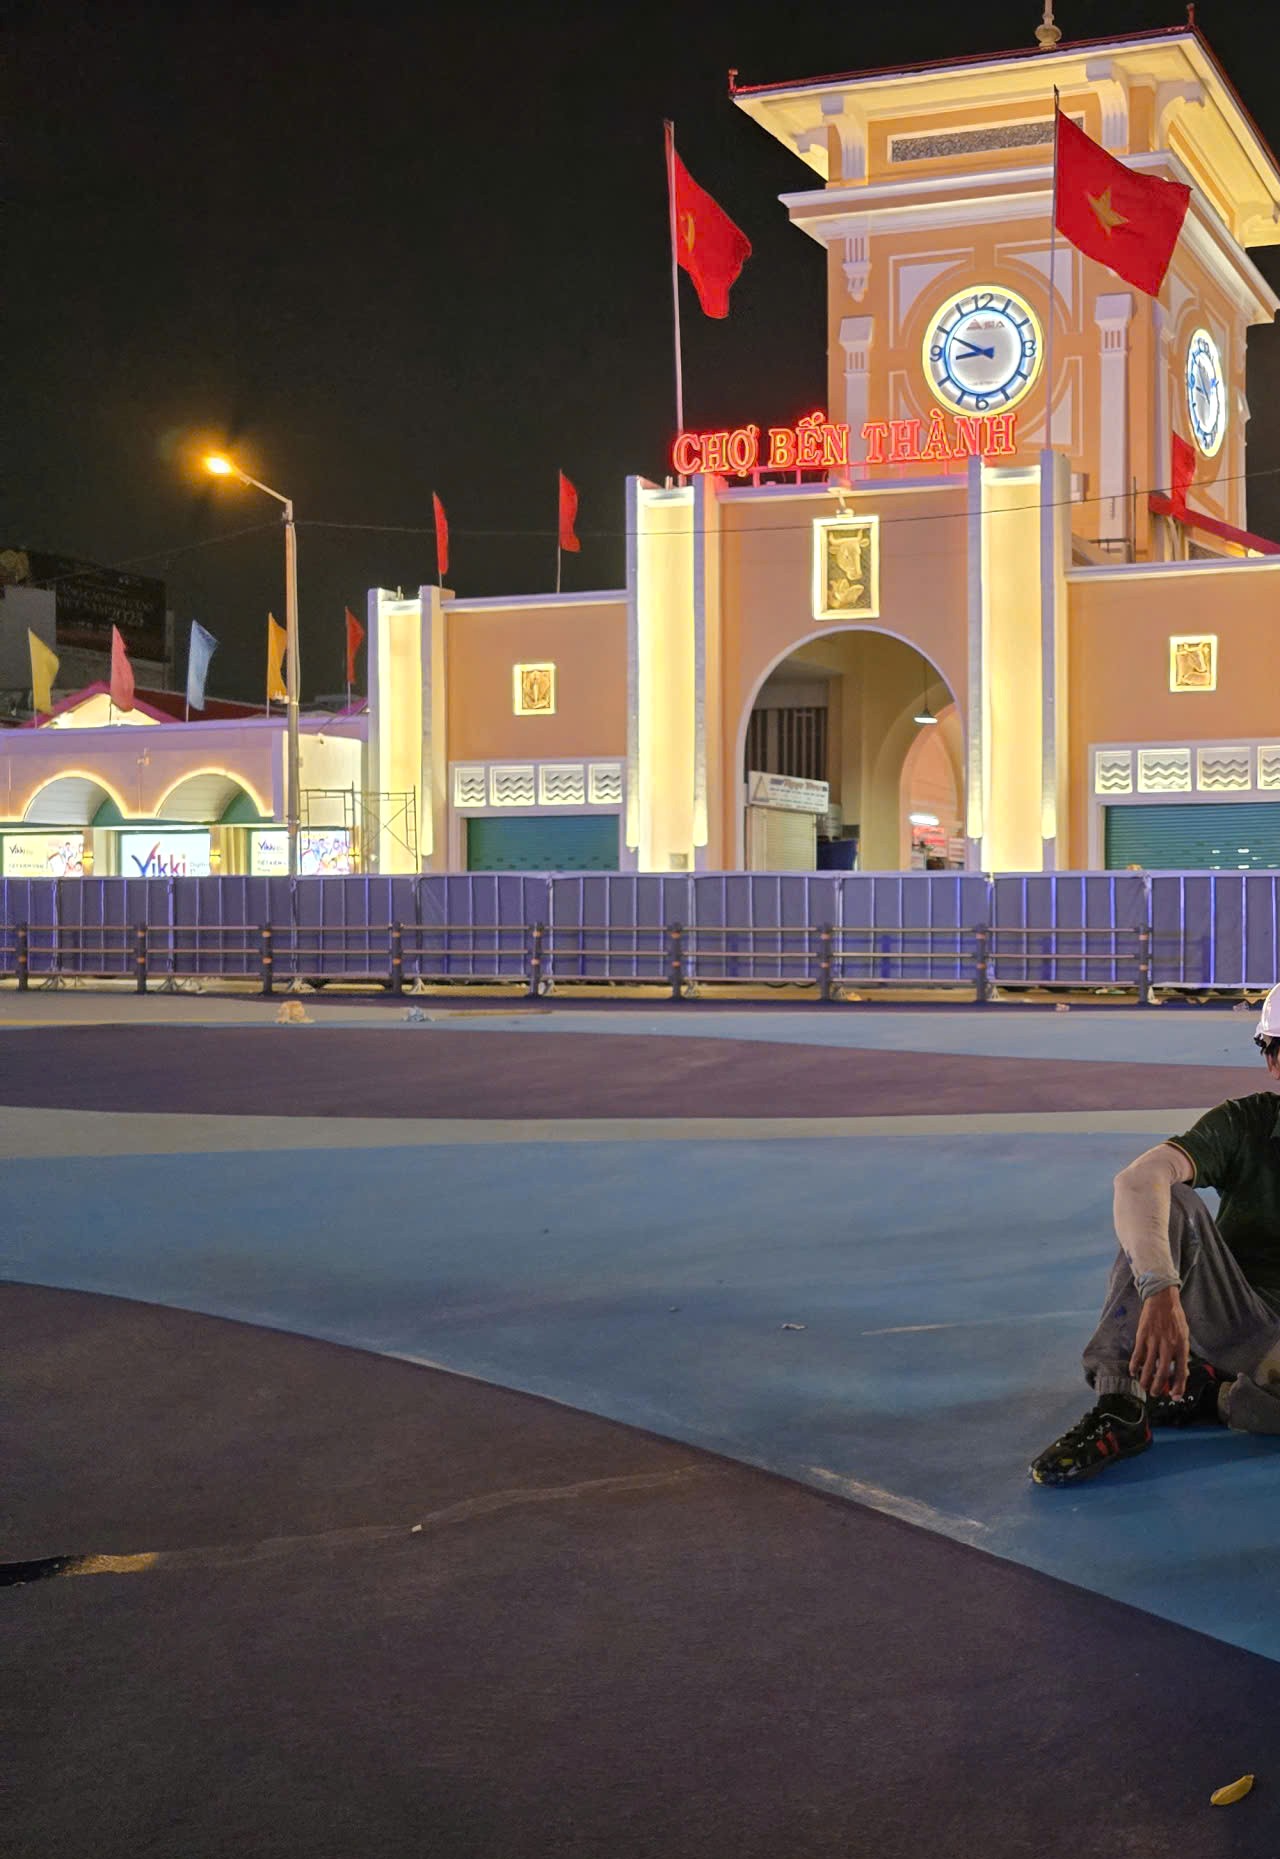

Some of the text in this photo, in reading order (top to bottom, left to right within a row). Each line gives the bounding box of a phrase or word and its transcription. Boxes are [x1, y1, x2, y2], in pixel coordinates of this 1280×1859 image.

[971, 293, 994, 310] 12
[930, 345, 943, 362] 9
[673, 408, 1017, 478] CHỢ BẾN THÀNH
[131, 841, 186, 876] Vikki
